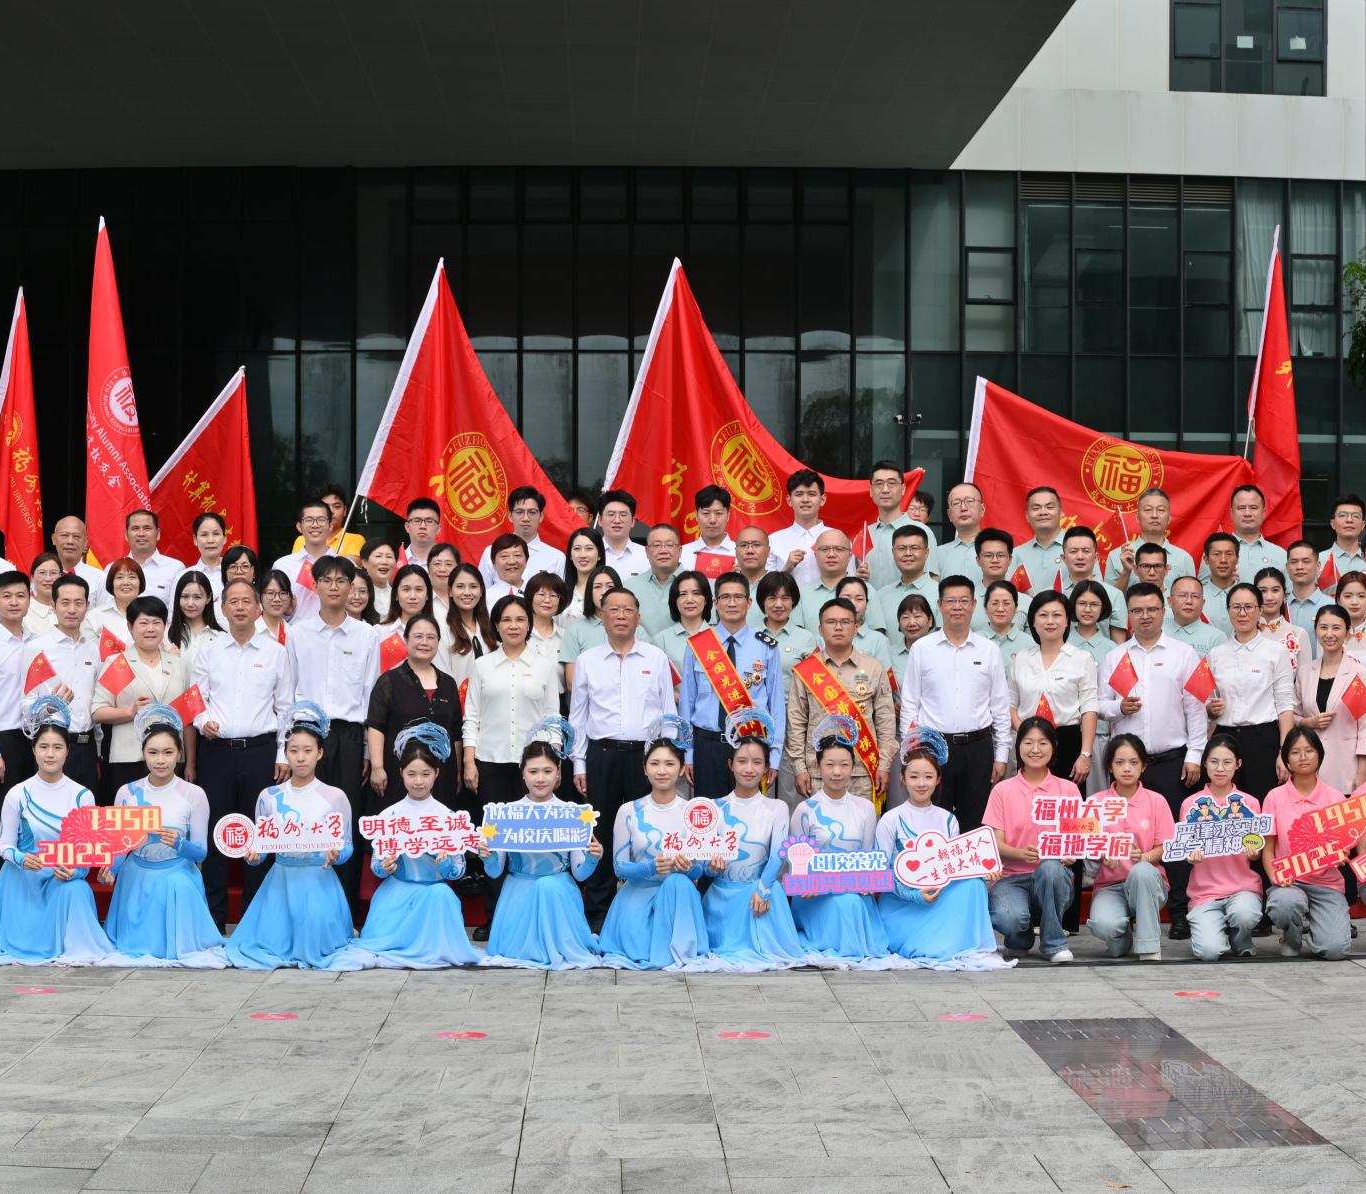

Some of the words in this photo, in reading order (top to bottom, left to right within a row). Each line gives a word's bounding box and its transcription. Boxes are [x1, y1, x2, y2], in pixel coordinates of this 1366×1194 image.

[96, 427, 123, 462] Alumni
[118, 461, 153, 513] Associatio
[1099, 452, 1148, 494] 福
[12, 489, 38, 534] UNIVERSITY
[89, 807, 161, 831] 1958
[488, 804, 577, 821] 以福大为荣
[1034, 798, 1125, 821] 福州大学
[257, 814, 342, 840] 福州大学
[363, 813, 472, 836] 明德至诚
[502, 825, 588, 844] 为校庆喝彩
[1175, 815, 1272, 842] 严谨求实的
[37, 841, 112, 866] 2025
[261, 843, 292, 851] FUZHOU
[295, 841, 342, 850] UNIVERSITY
[375, 832, 481, 856] 博学远志
[663, 831, 737, 852] 福州大学
[923, 835, 991, 865] 一朝福大人
[1040, 834, 1132, 857] 福地学府
[1164, 834, 1243, 860] 治学精神
[812, 850, 887, 872] 母校荣光
[916, 855, 983, 884] 一生福大情
[1274, 839, 1347, 883] 2025
